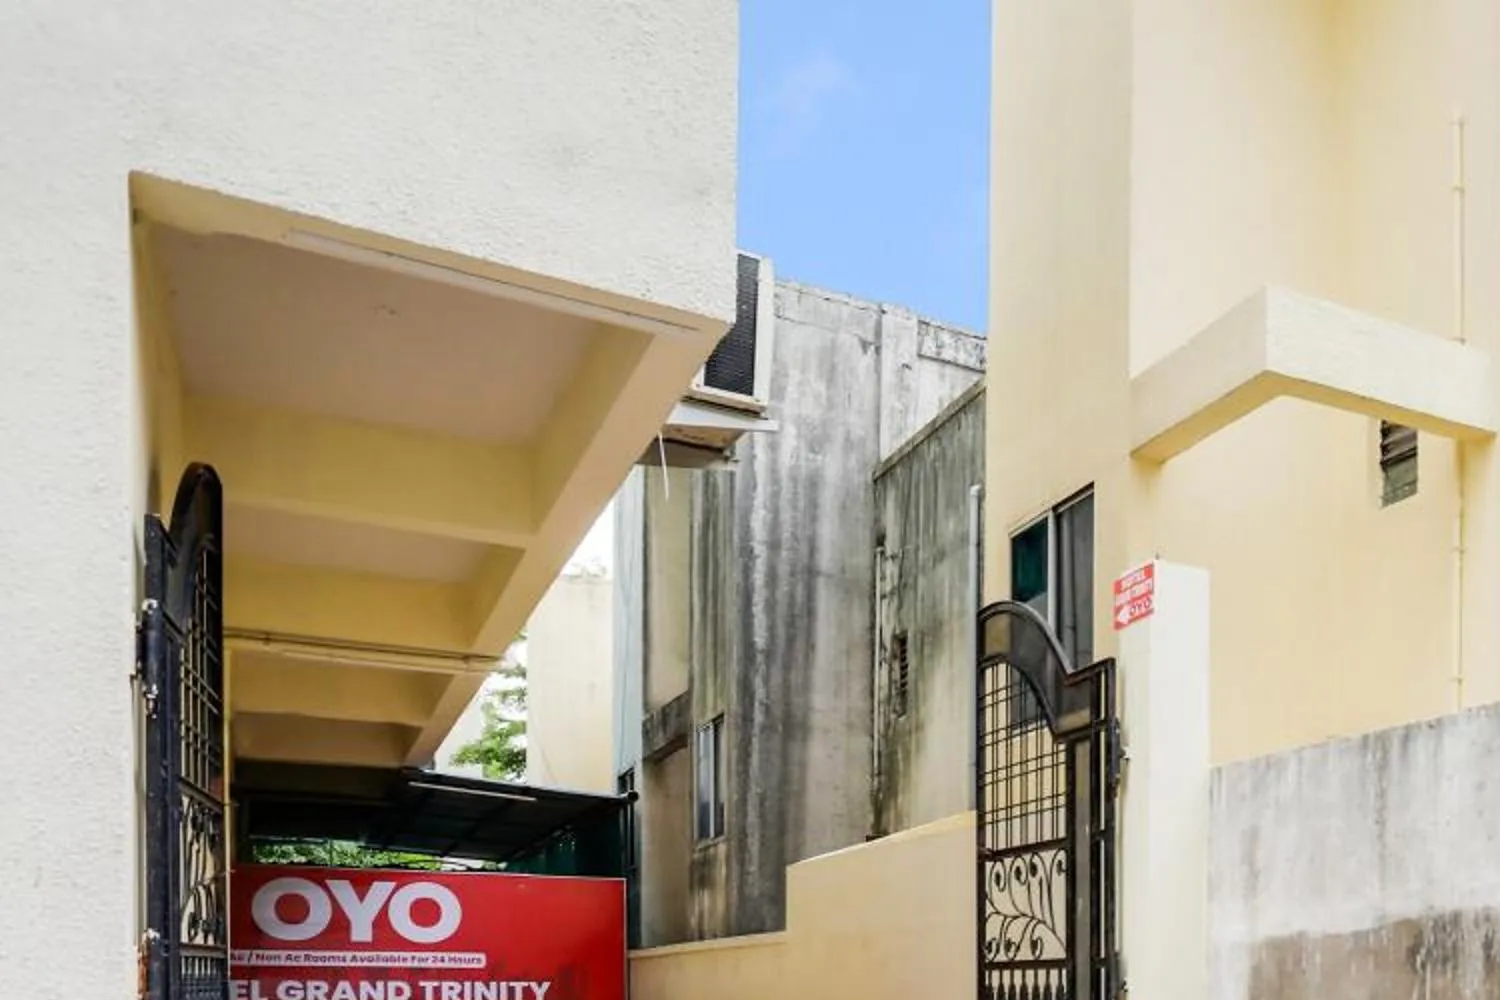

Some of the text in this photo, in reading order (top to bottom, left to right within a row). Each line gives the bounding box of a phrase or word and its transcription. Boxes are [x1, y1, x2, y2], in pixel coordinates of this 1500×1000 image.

[251, 877, 462, 943] OYO
[303, 953, 347, 964] Rooms
[350, 953, 408, 965] Available
[431, 954, 446, 965] 24
